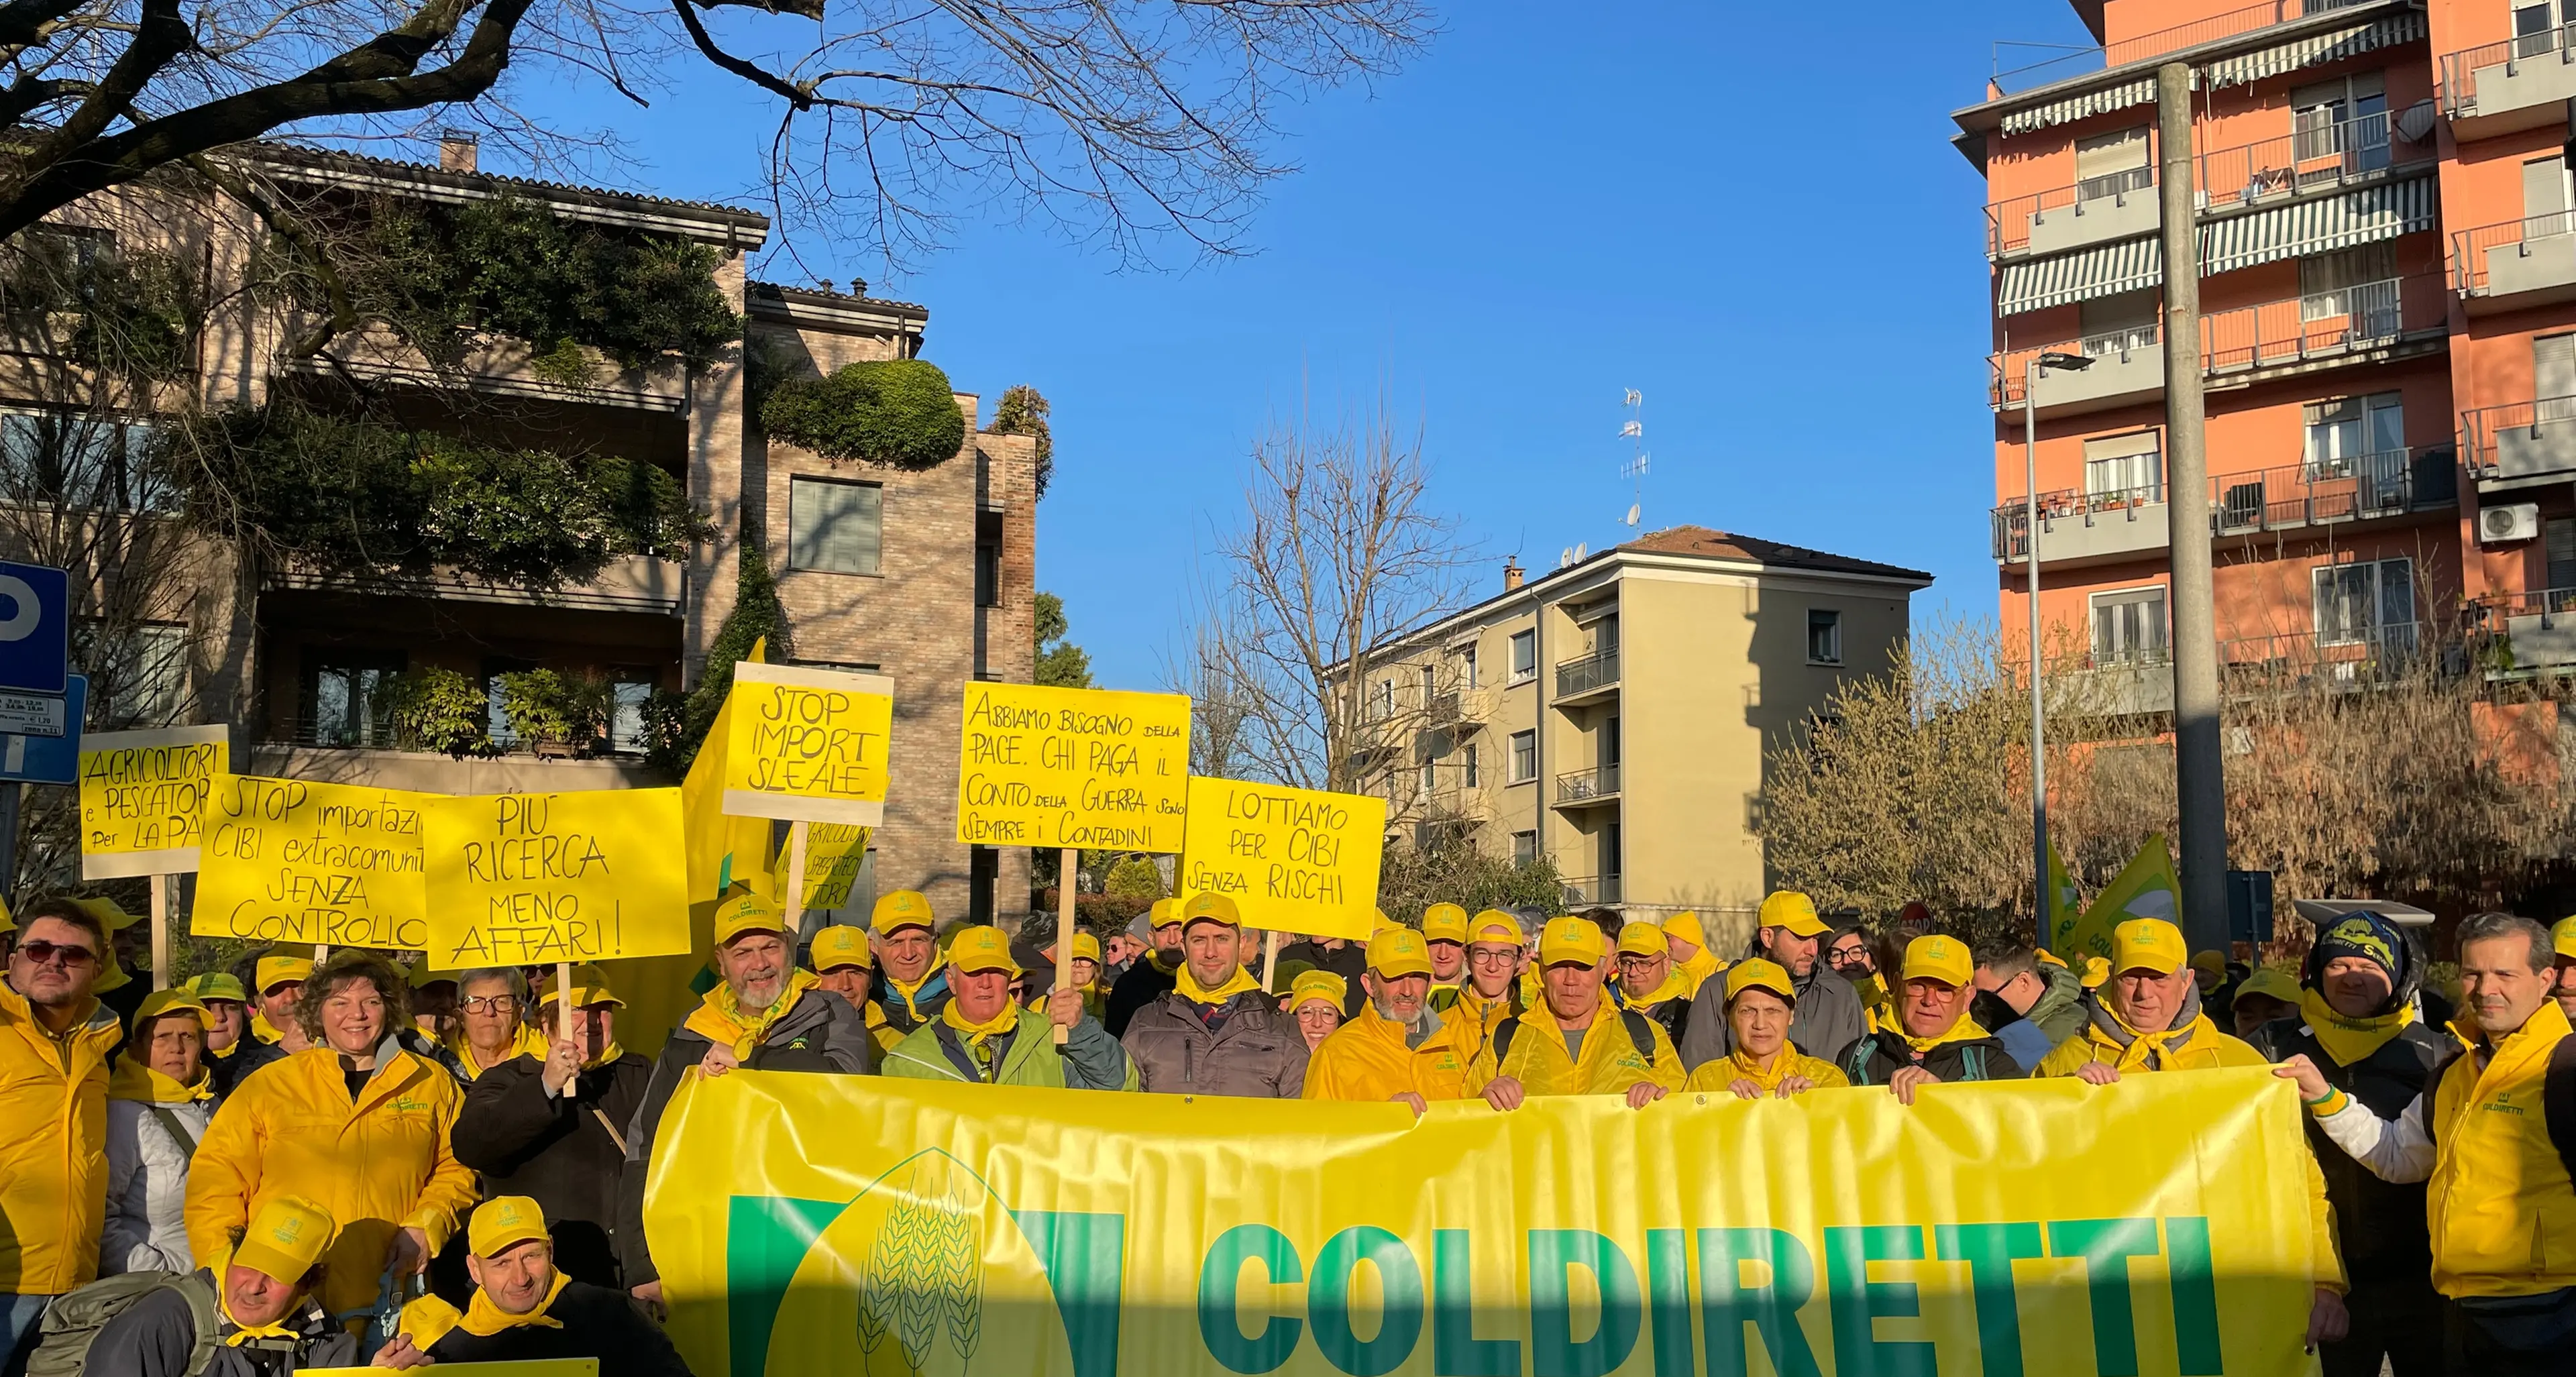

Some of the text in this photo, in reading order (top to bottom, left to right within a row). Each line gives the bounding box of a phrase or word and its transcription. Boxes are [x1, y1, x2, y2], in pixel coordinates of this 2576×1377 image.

[761, 685, 850, 726] STOP
[969, 691, 1180, 737] ABBIAMO BISOGNO DELLA
[753, 723, 880, 763] IMPORT
[969, 733, 1028, 766] PACE.
[1042, 736, 1075, 771] CHI
[1089, 741, 1139, 777] PAGA
[85, 743, 217, 787] AGRICOLTORI
[85, 808, 94, 822] e
[221, 777, 423, 836] STOP importazi
[967, 773, 1030, 807] CONTO
[1034, 795, 1068, 808] DELLA
[1081, 778, 1148, 816] GUERRA
[1227, 790, 1348, 830] LOTTIAMO
[133, 822, 160, 848] LA
[165, 815, 206, 848] PA
[213, 823, 262, 859] CIBI
[806, 822, 871, 845] GRICOLTORI
[963, 812, 1025, 841] SEMPRE
[1059, 811, 1152, 847] CONTADINI
[1227, 828, 1340, 867] PER CIBI
[463, 834, 610, 883] RICERCA
[267, 868, 369, 909] SENZA
[1188, 861, 1344, 905] SENZA RISCHI
[229, 899, 427, 947] CONTROLLO
[490, 891, 578, 924] MENO
[729, 909, 768, 923] COLDIRETTI
[1196, 1215, 2226, 1377] COLDIRETTI
